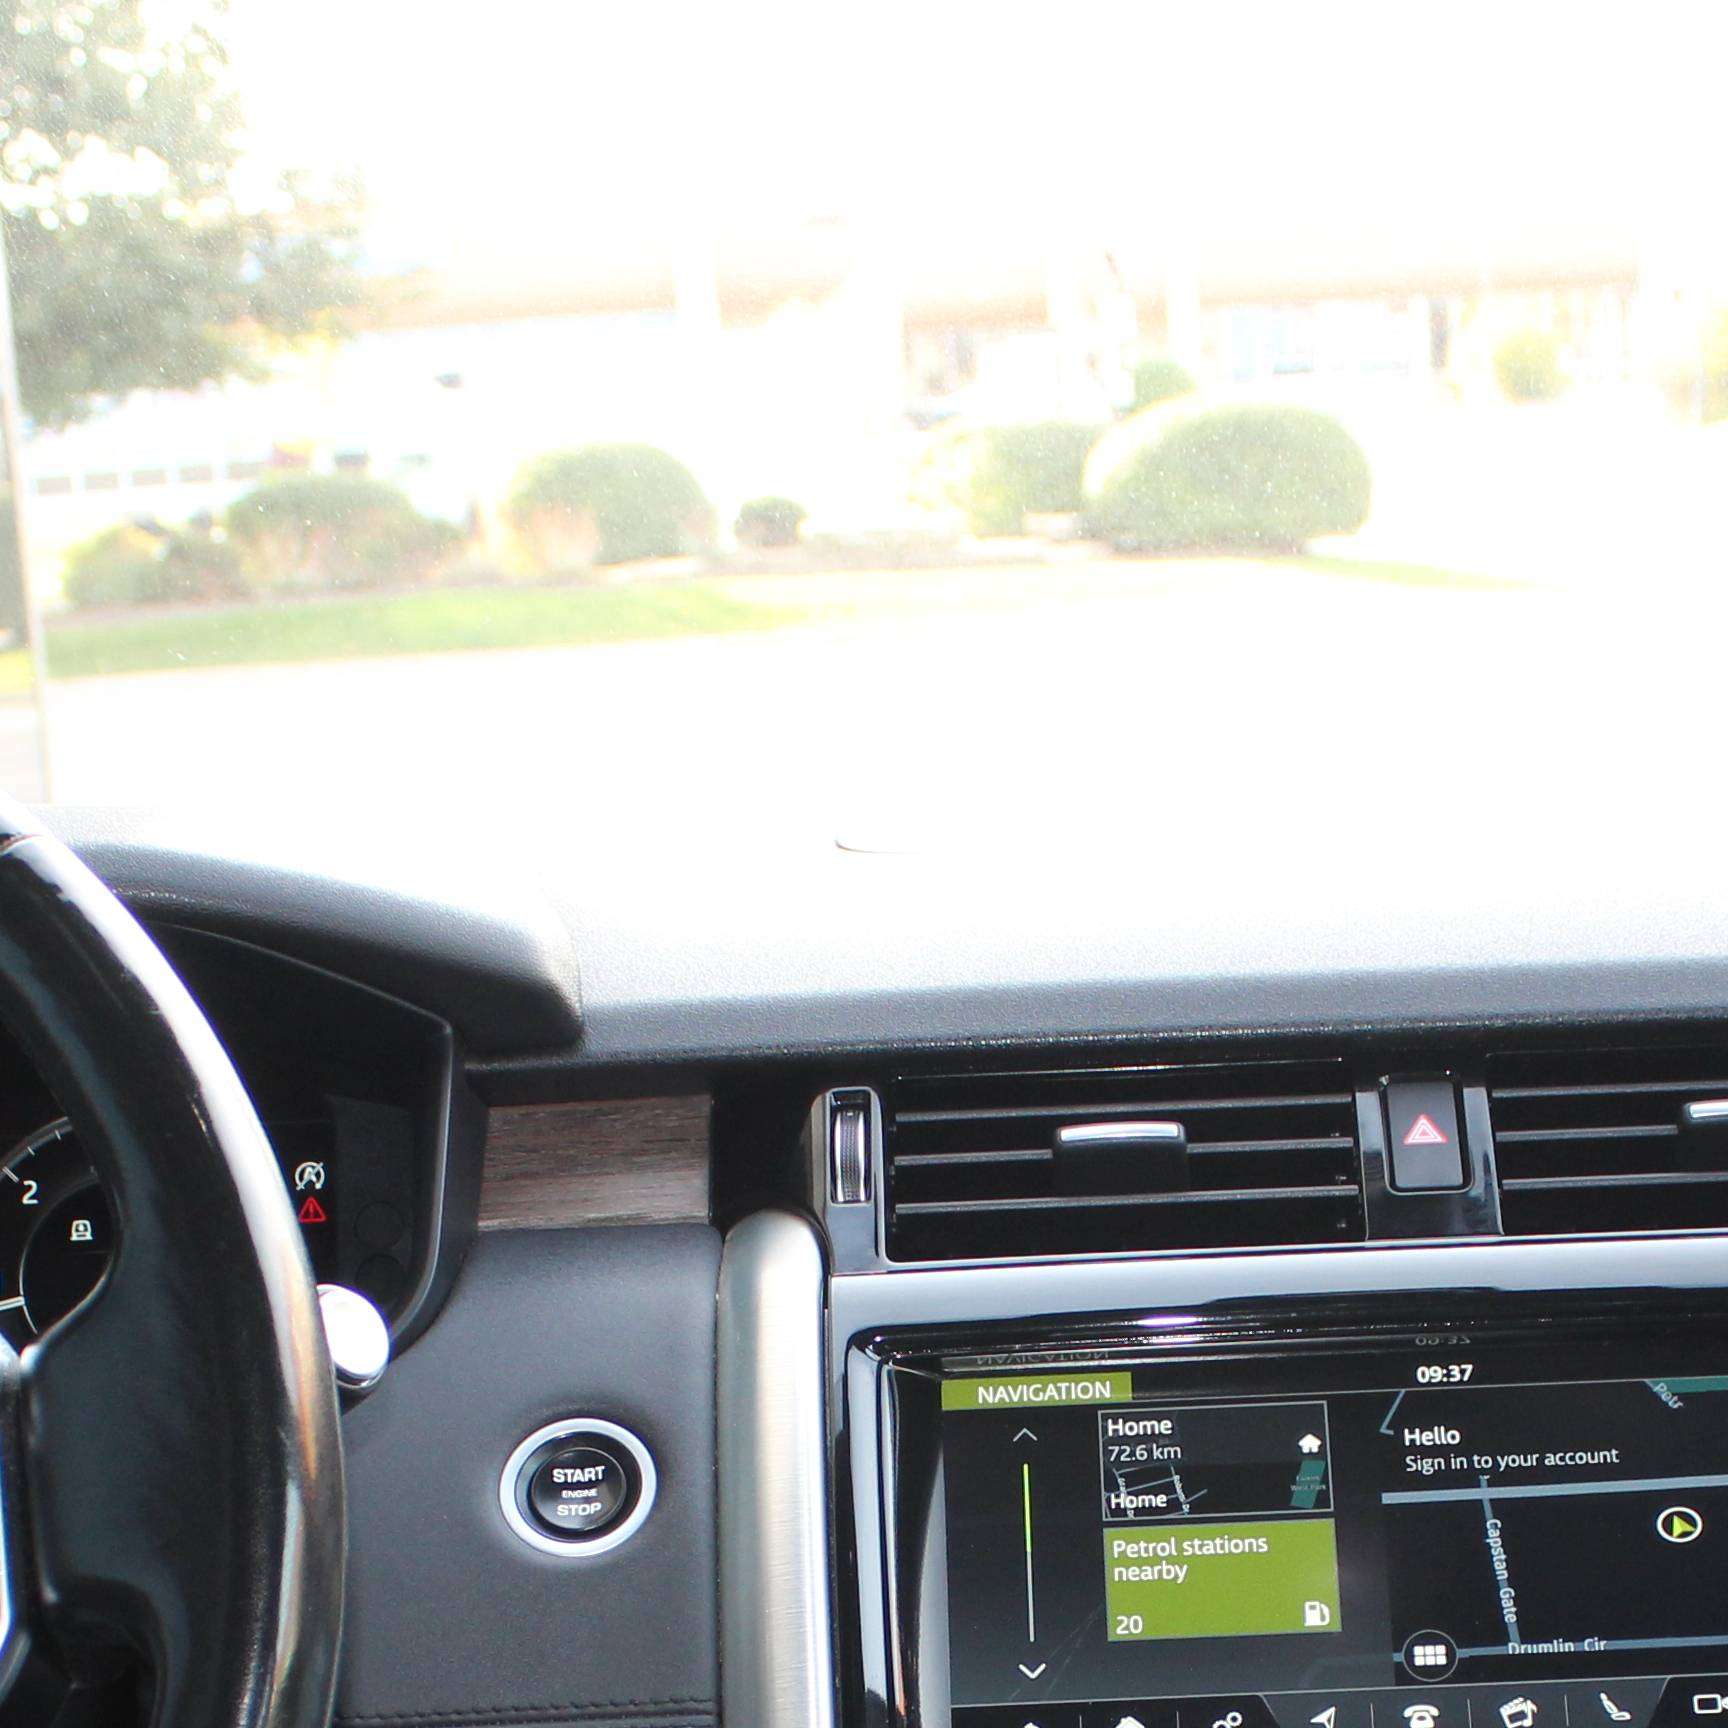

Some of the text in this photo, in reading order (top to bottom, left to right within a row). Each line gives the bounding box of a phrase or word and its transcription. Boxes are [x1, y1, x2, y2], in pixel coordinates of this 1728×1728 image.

[21, 1180, 38, 1205] 2
[1416, 1364, 1473, 1383] 09:37
[978, 1380, 1111, 1404] NAVIGATION
[1107, 1417, 1173, 1437] Home
[1403, 1426, 1461, 1446] Hello
[1108, 1443, 1182, 1462] 72.6 km
[1405, 1448, 1620, 1475] Sign in to your account
[552, 1465, 605, 1483] START
[561, 1488, 598, 1499] ENGINE
[1110, 1493, 1168, 1509] Home
[557, 1502, 602, 1516] STOP
[1112, 1535, 1269, 1559] Petrol stations
[1113, 1562, 1188, 1584] nearby
[1486, 1518, 1517, 1624] Capstan Gate
[1115, 1615, 1143, 1634] 20
[1507, 1637, 1607, 1655] Drumlin Cir
